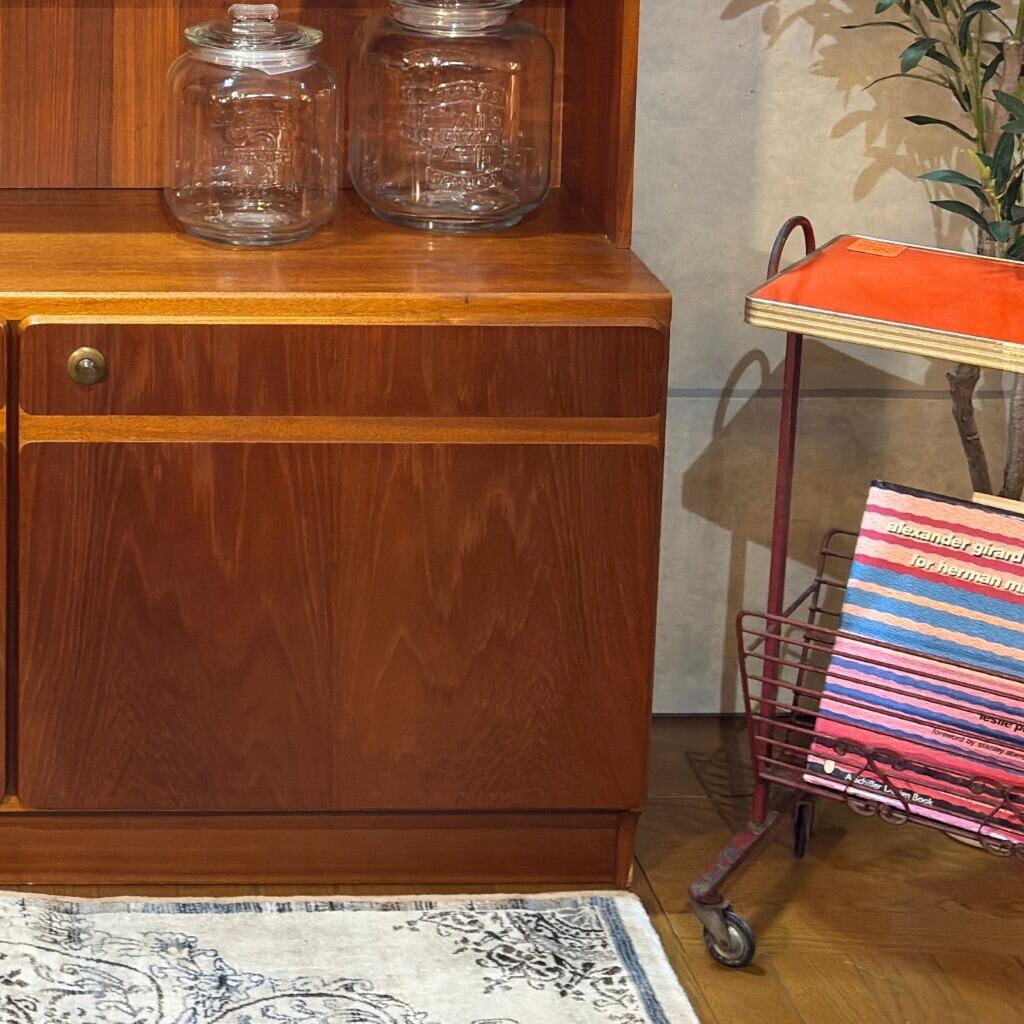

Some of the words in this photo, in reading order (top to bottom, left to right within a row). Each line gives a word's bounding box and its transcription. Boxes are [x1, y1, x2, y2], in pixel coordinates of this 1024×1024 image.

[887, 522, 971, 550] alexander
[973, 543, 1024, 564] girard
[910, 555, 936, 571] for
[937, 561, 1002, 587] herman
[844, 773, 852, 781] A
[912, 792, 934, 806] Book
